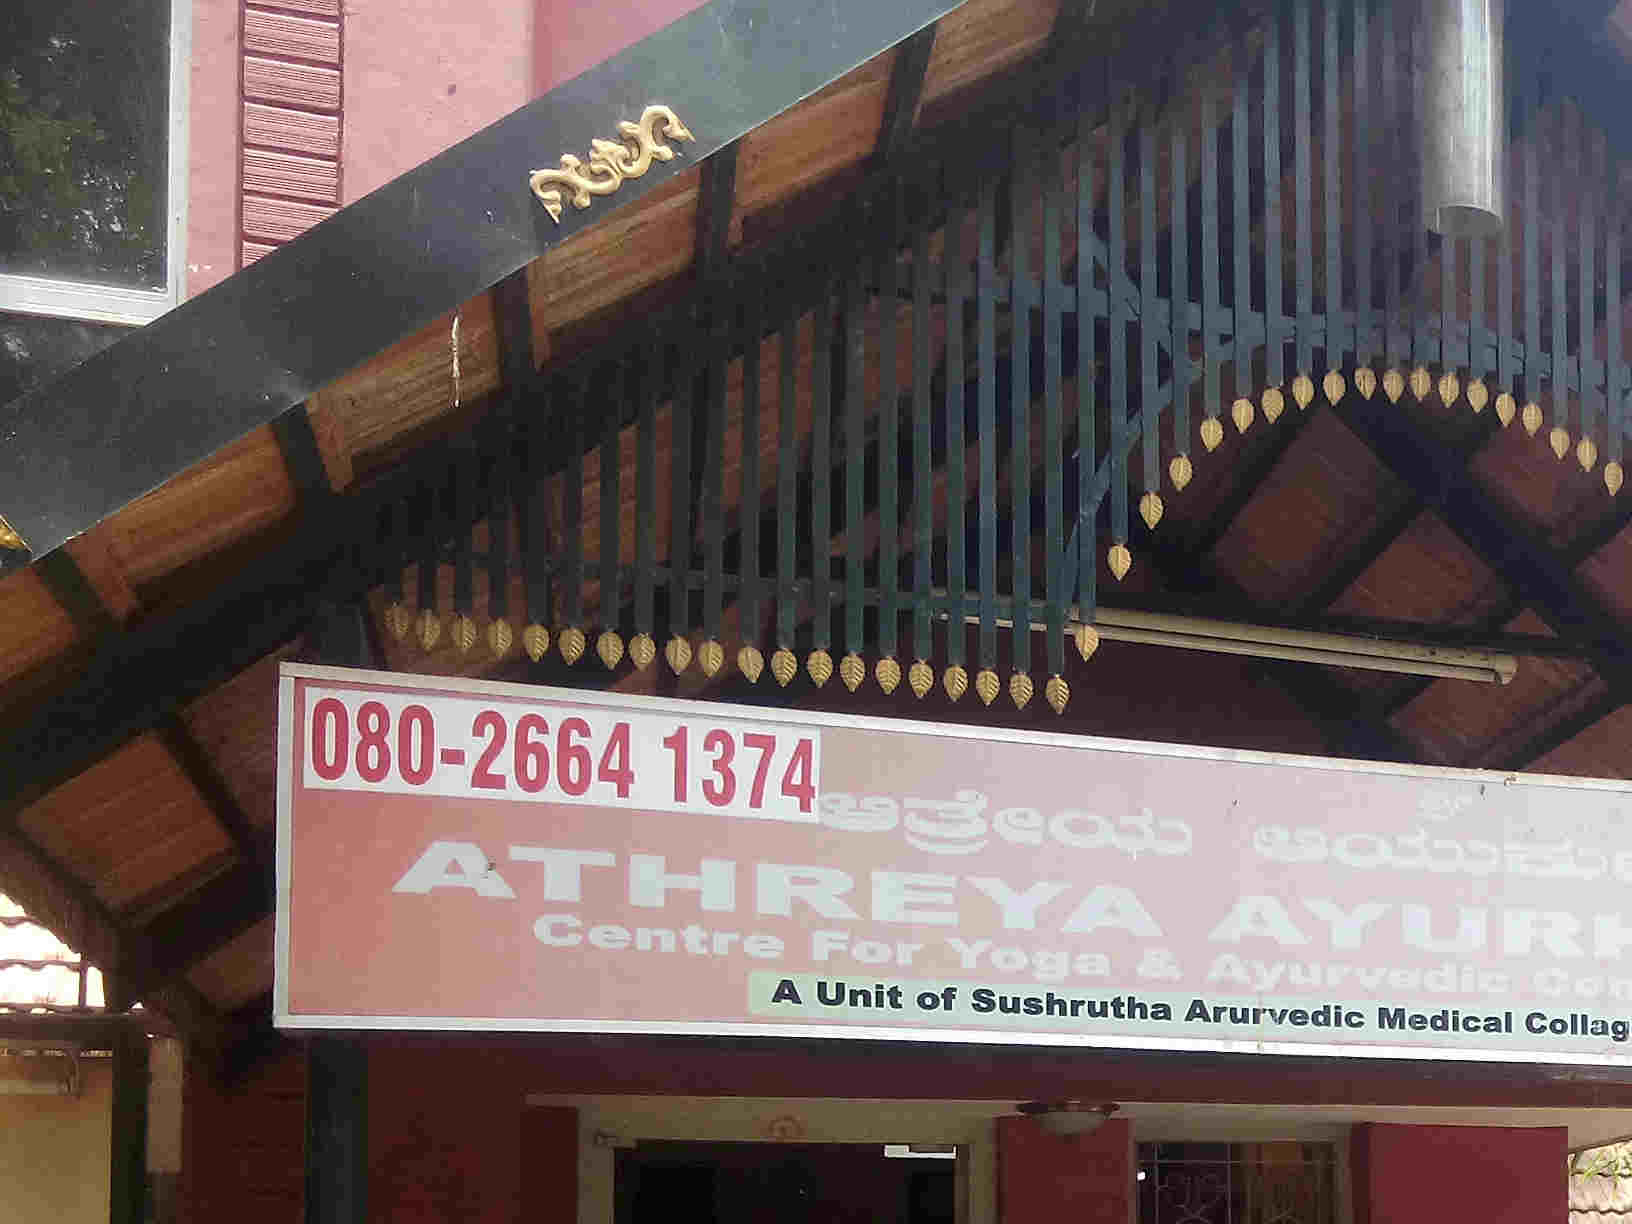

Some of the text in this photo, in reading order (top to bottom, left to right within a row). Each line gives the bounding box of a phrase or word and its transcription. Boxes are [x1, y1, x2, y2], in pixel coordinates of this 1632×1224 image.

[310, 697, 817, 814] 080-2664 1374
[391, 840, 1165, 938] ATHREYA
[532, 913, 785, 960] Centre
[809, 930, 924, 967] For
[946, 936, 1113, 982] Yoga
[1137, 949, 1183, 982] &
[1206, 952, 1513, 995] Ayurvedic
[771, 979, 802, 1006] A
[816, 980, 903, 1010] Unit
[915, 984, 957, 1012] of
[970, 987, 1172, 1022] Sushrutha
[1184, 998, 1365, 1030] Arurvedic
[1377, 1006, 1513, 1034] Medical
